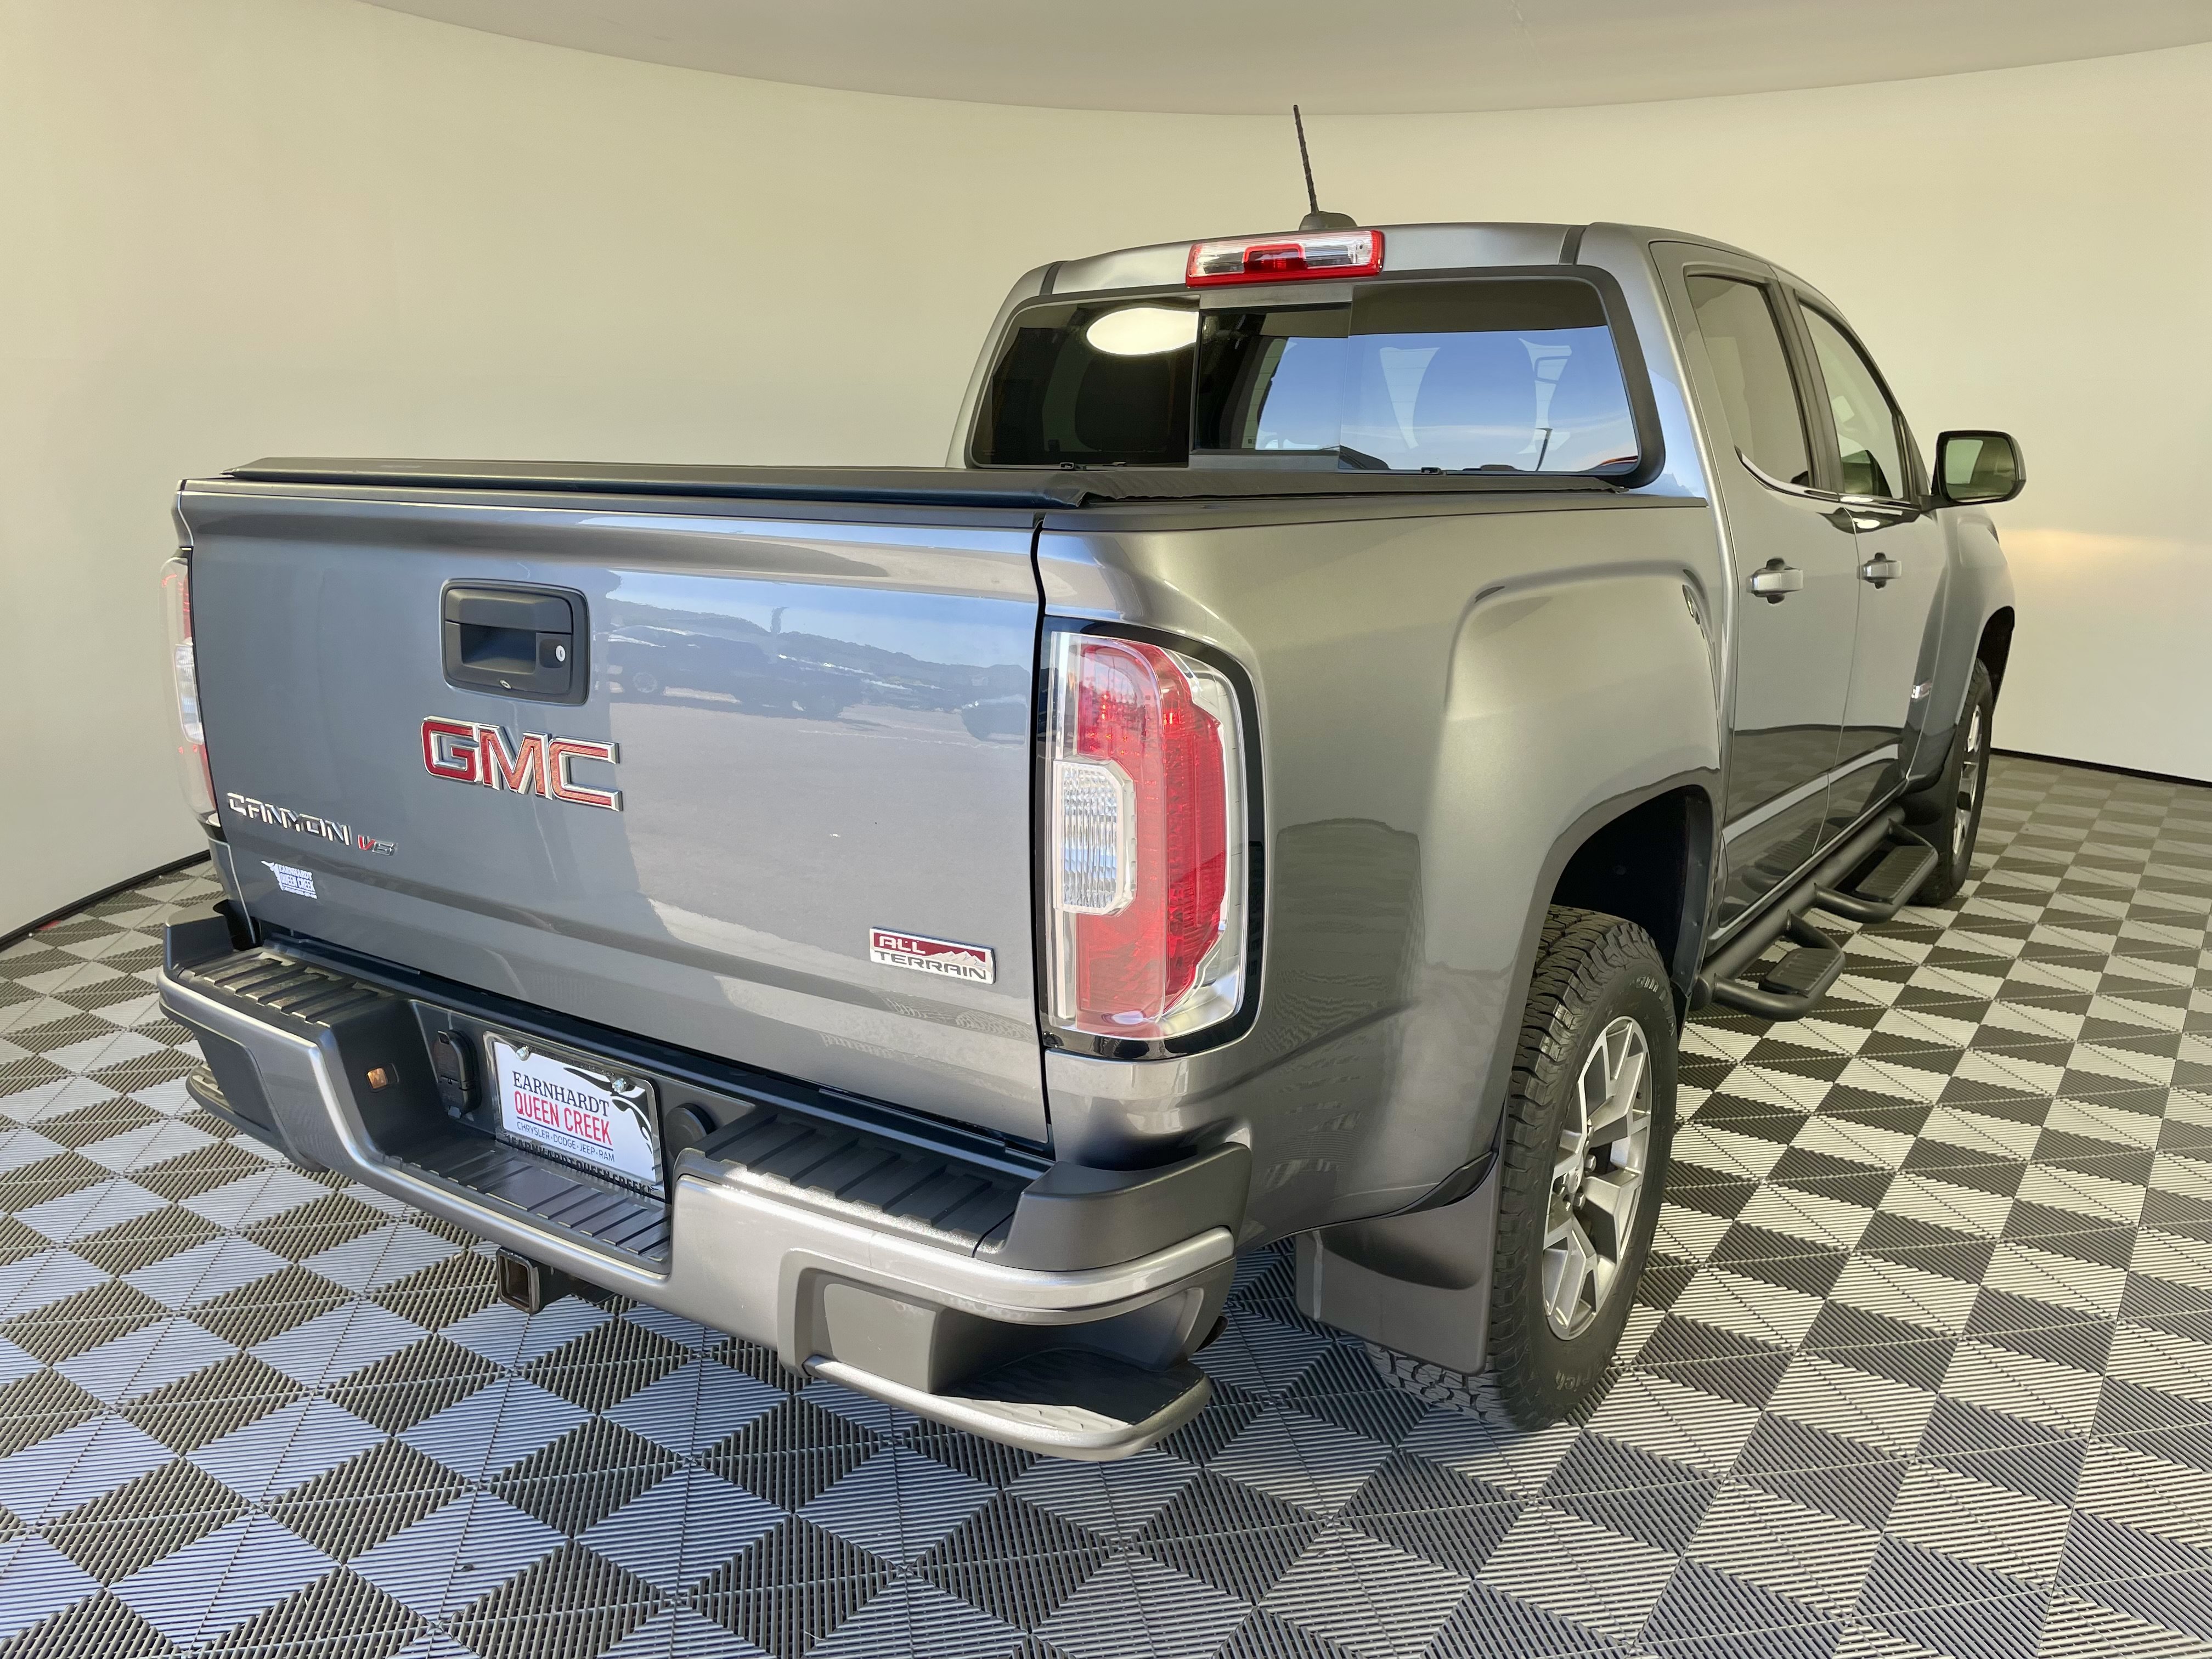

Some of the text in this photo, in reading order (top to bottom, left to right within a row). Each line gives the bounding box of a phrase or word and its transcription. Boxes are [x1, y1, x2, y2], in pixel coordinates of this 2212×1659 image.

[421, 715, 623, 812] GMC
[227, 792, 352, 845] CANYON
[874, 950, 986, 979] TERRAIN
[879, 935, 926, 954] ALL
[512, 1070, 610, 1116] EARNHARDT
[514, 1091, 612, 1146] QUEEN CREEK
[517, 1121, 615, 1163] CHRYSLER DODGE JEEP RAM
